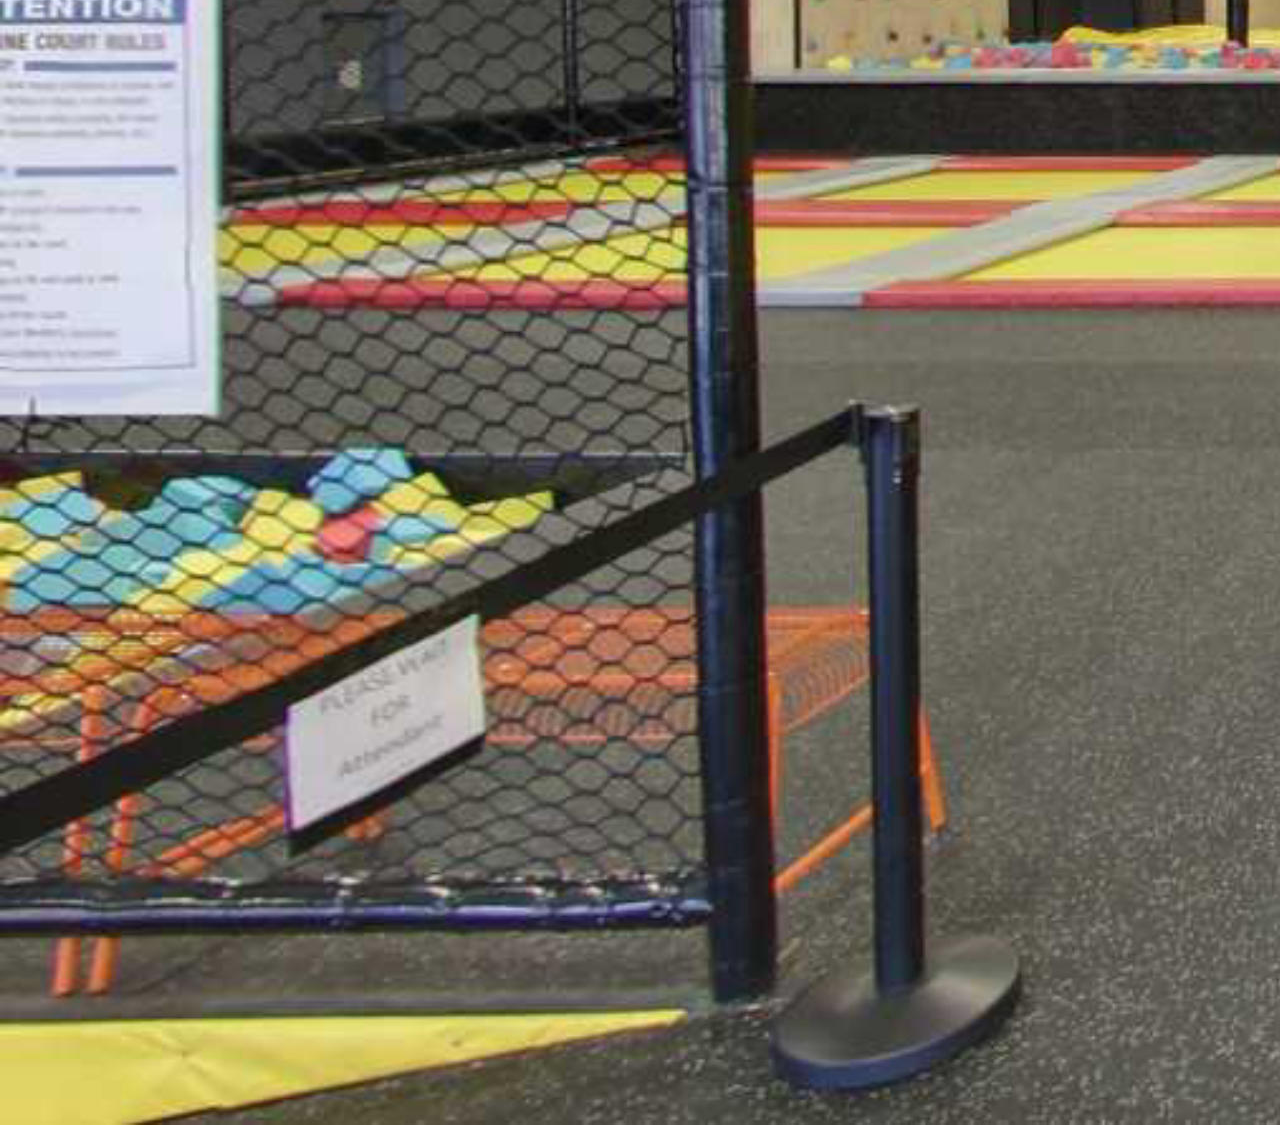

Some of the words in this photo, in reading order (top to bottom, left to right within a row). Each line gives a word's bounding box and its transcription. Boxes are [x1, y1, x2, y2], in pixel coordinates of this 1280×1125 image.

[35, 32, 97, 51] COURT
[106, 32, 165, 50] RULES
[320, 663, 394, 714] PLEASE
[396, 638, 447, 675] WAIT
[371, 694, 412, 727] FOR
[339, 714, 442, 776] Attendant
